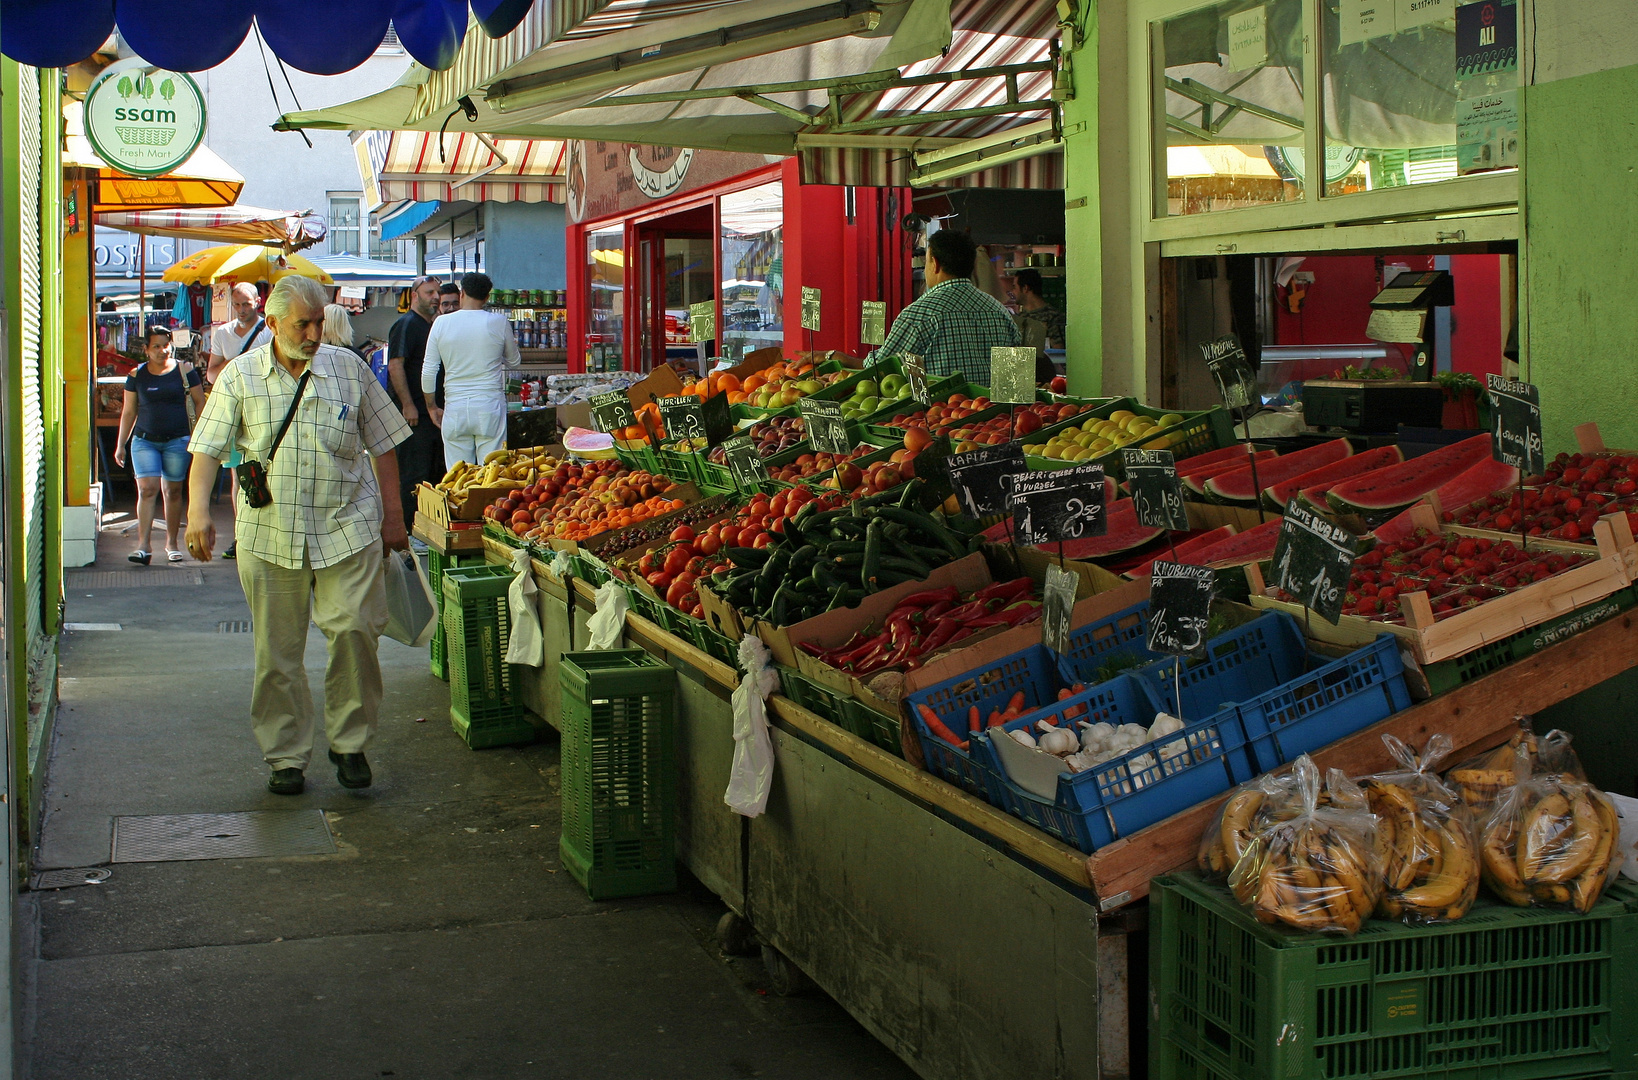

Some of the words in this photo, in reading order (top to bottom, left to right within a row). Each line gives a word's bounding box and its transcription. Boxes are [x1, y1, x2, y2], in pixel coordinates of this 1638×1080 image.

[1479, 25, 1495, 47] ALI
[115, 107, 176, 123] ssam
[119, 148, 144, 158] Fresh
[147, 149, 172, 158] Mart
[1290, 500, 1312, 525] ROTE
[1153, 560, 1212, 579] KNOBLAUCH
